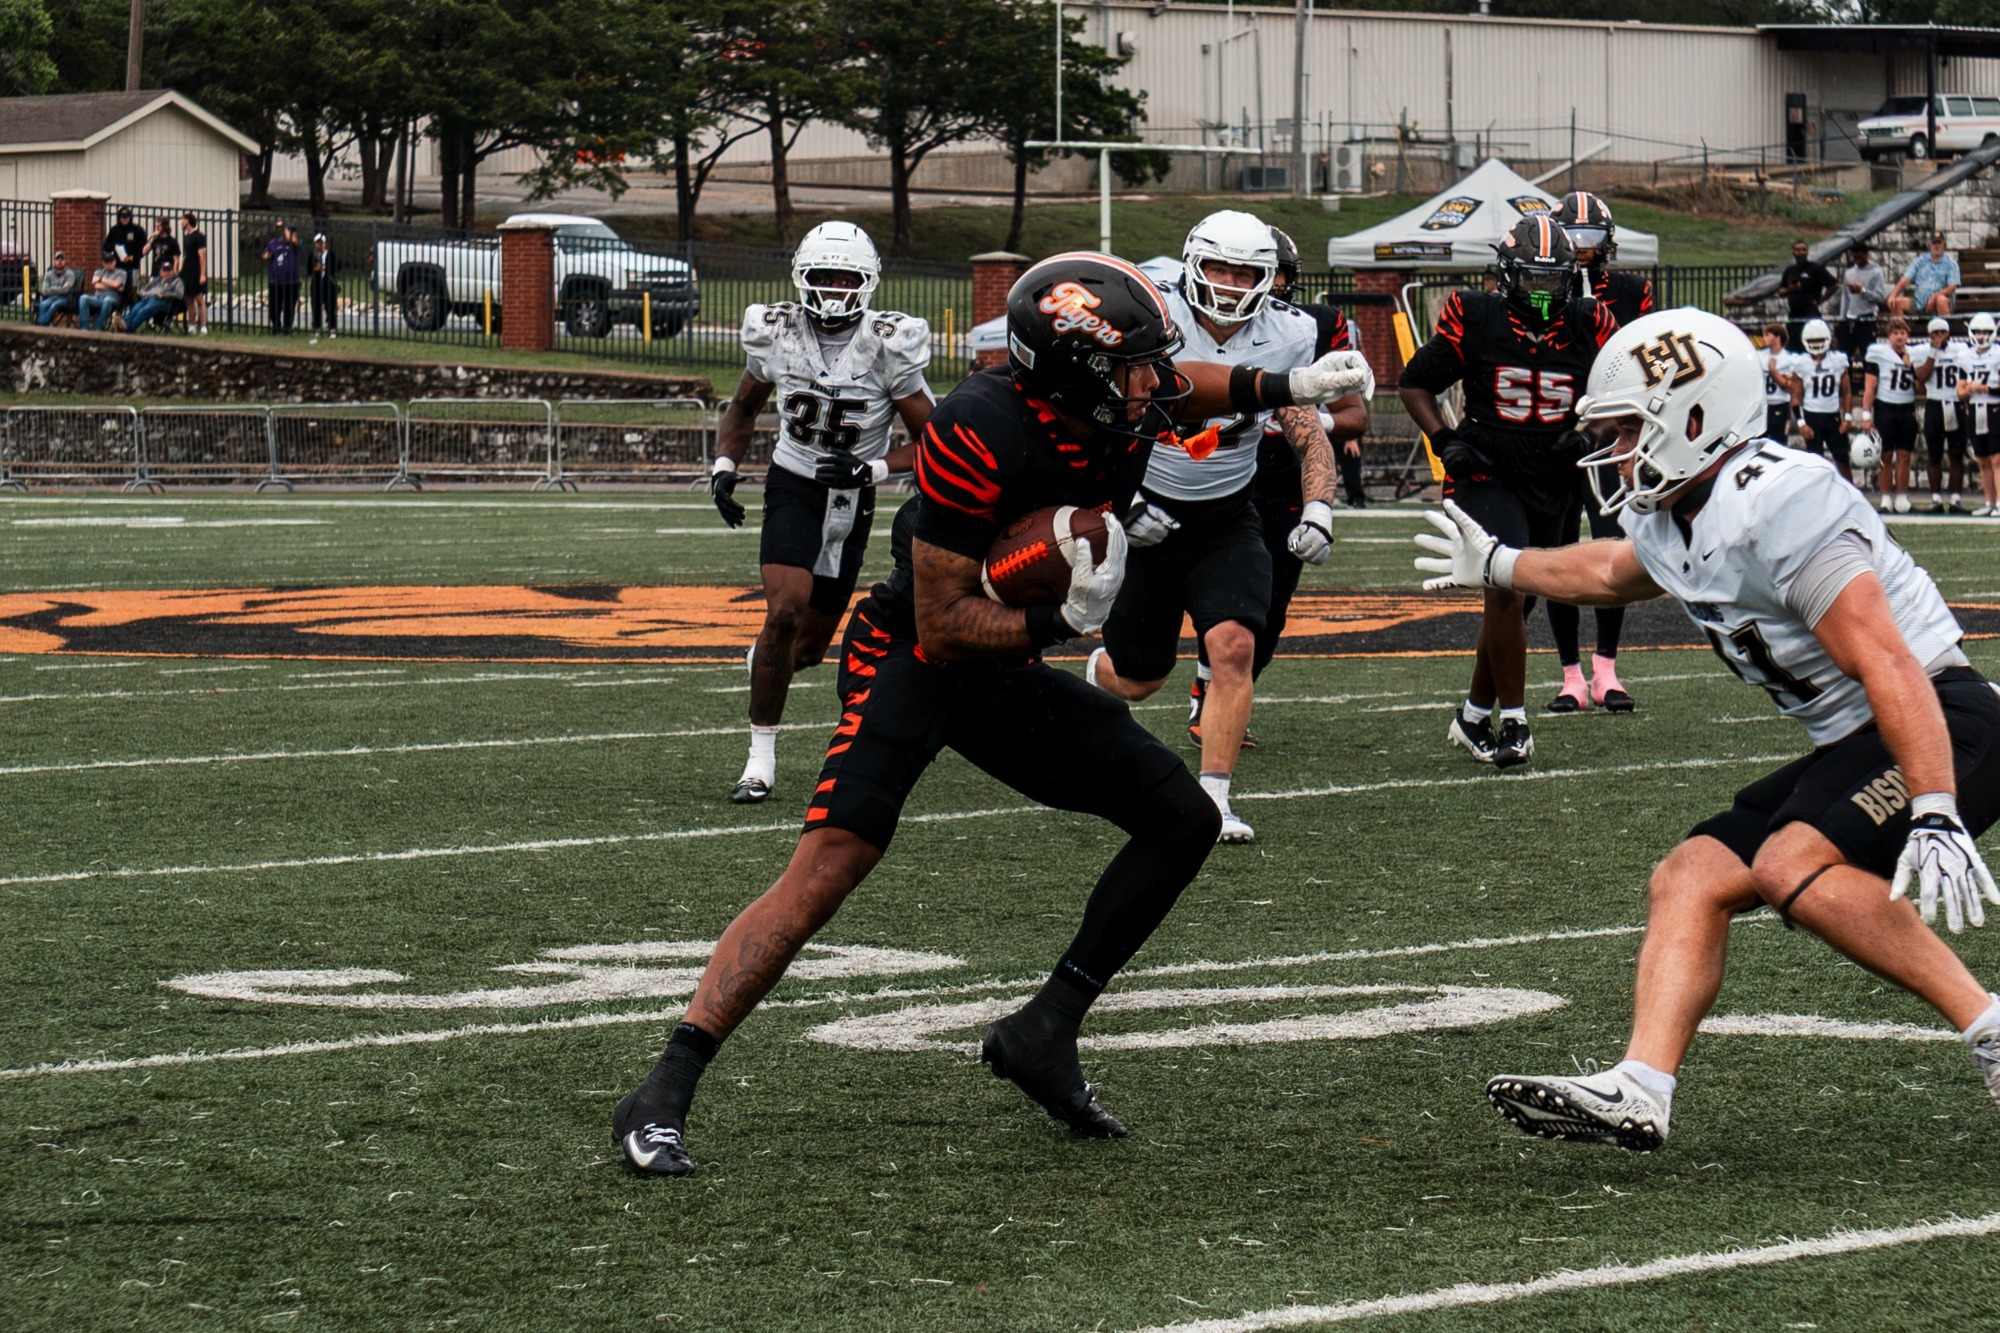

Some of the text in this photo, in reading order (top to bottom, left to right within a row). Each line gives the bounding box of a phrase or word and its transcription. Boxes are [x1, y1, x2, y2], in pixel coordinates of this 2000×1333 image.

[1039, 282, 1123, 347] Tigers
[1628, 330, 1705, 391] HU
[1890, 369, 1913, 391] 15
[1934, 365, 1958, 389] 16
[1494, 366, 1575, 423] 55
[1811, 374, 1836, 398] 10
[783, 390, 868, 453] 35
[1735, 450, 1787, 491] 41
